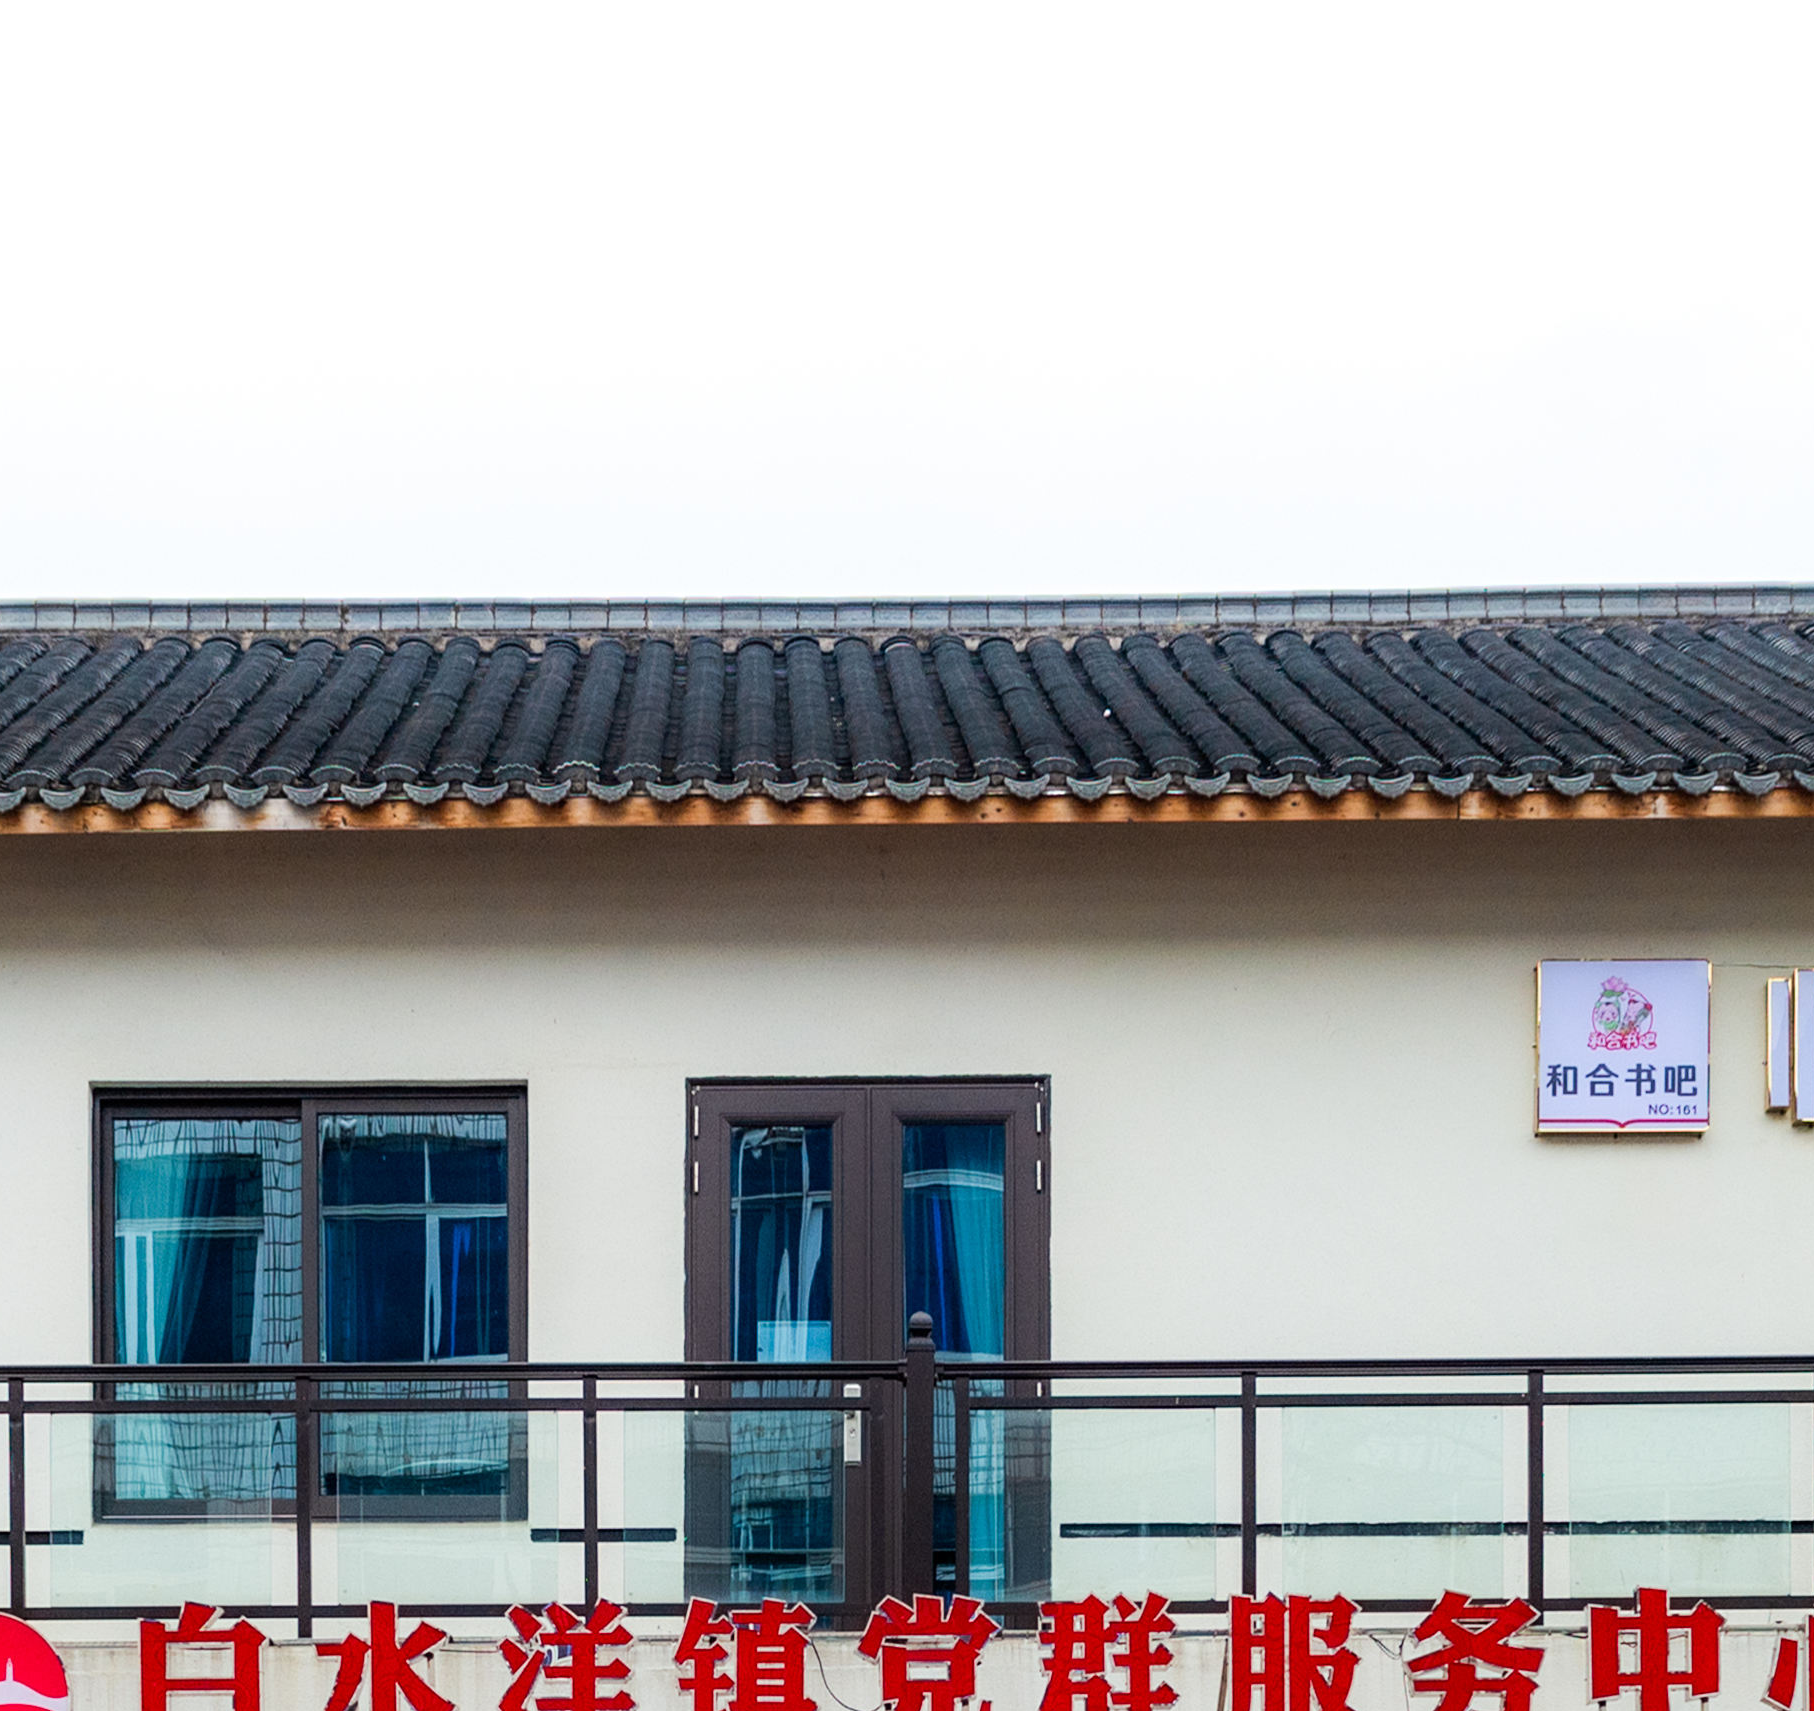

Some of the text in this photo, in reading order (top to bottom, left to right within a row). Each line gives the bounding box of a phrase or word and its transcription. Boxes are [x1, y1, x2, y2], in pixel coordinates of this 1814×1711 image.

[1546, 1063, 1698, 1097] 和合书吧
[1648, 1103, 1698, 1116] NO:161
